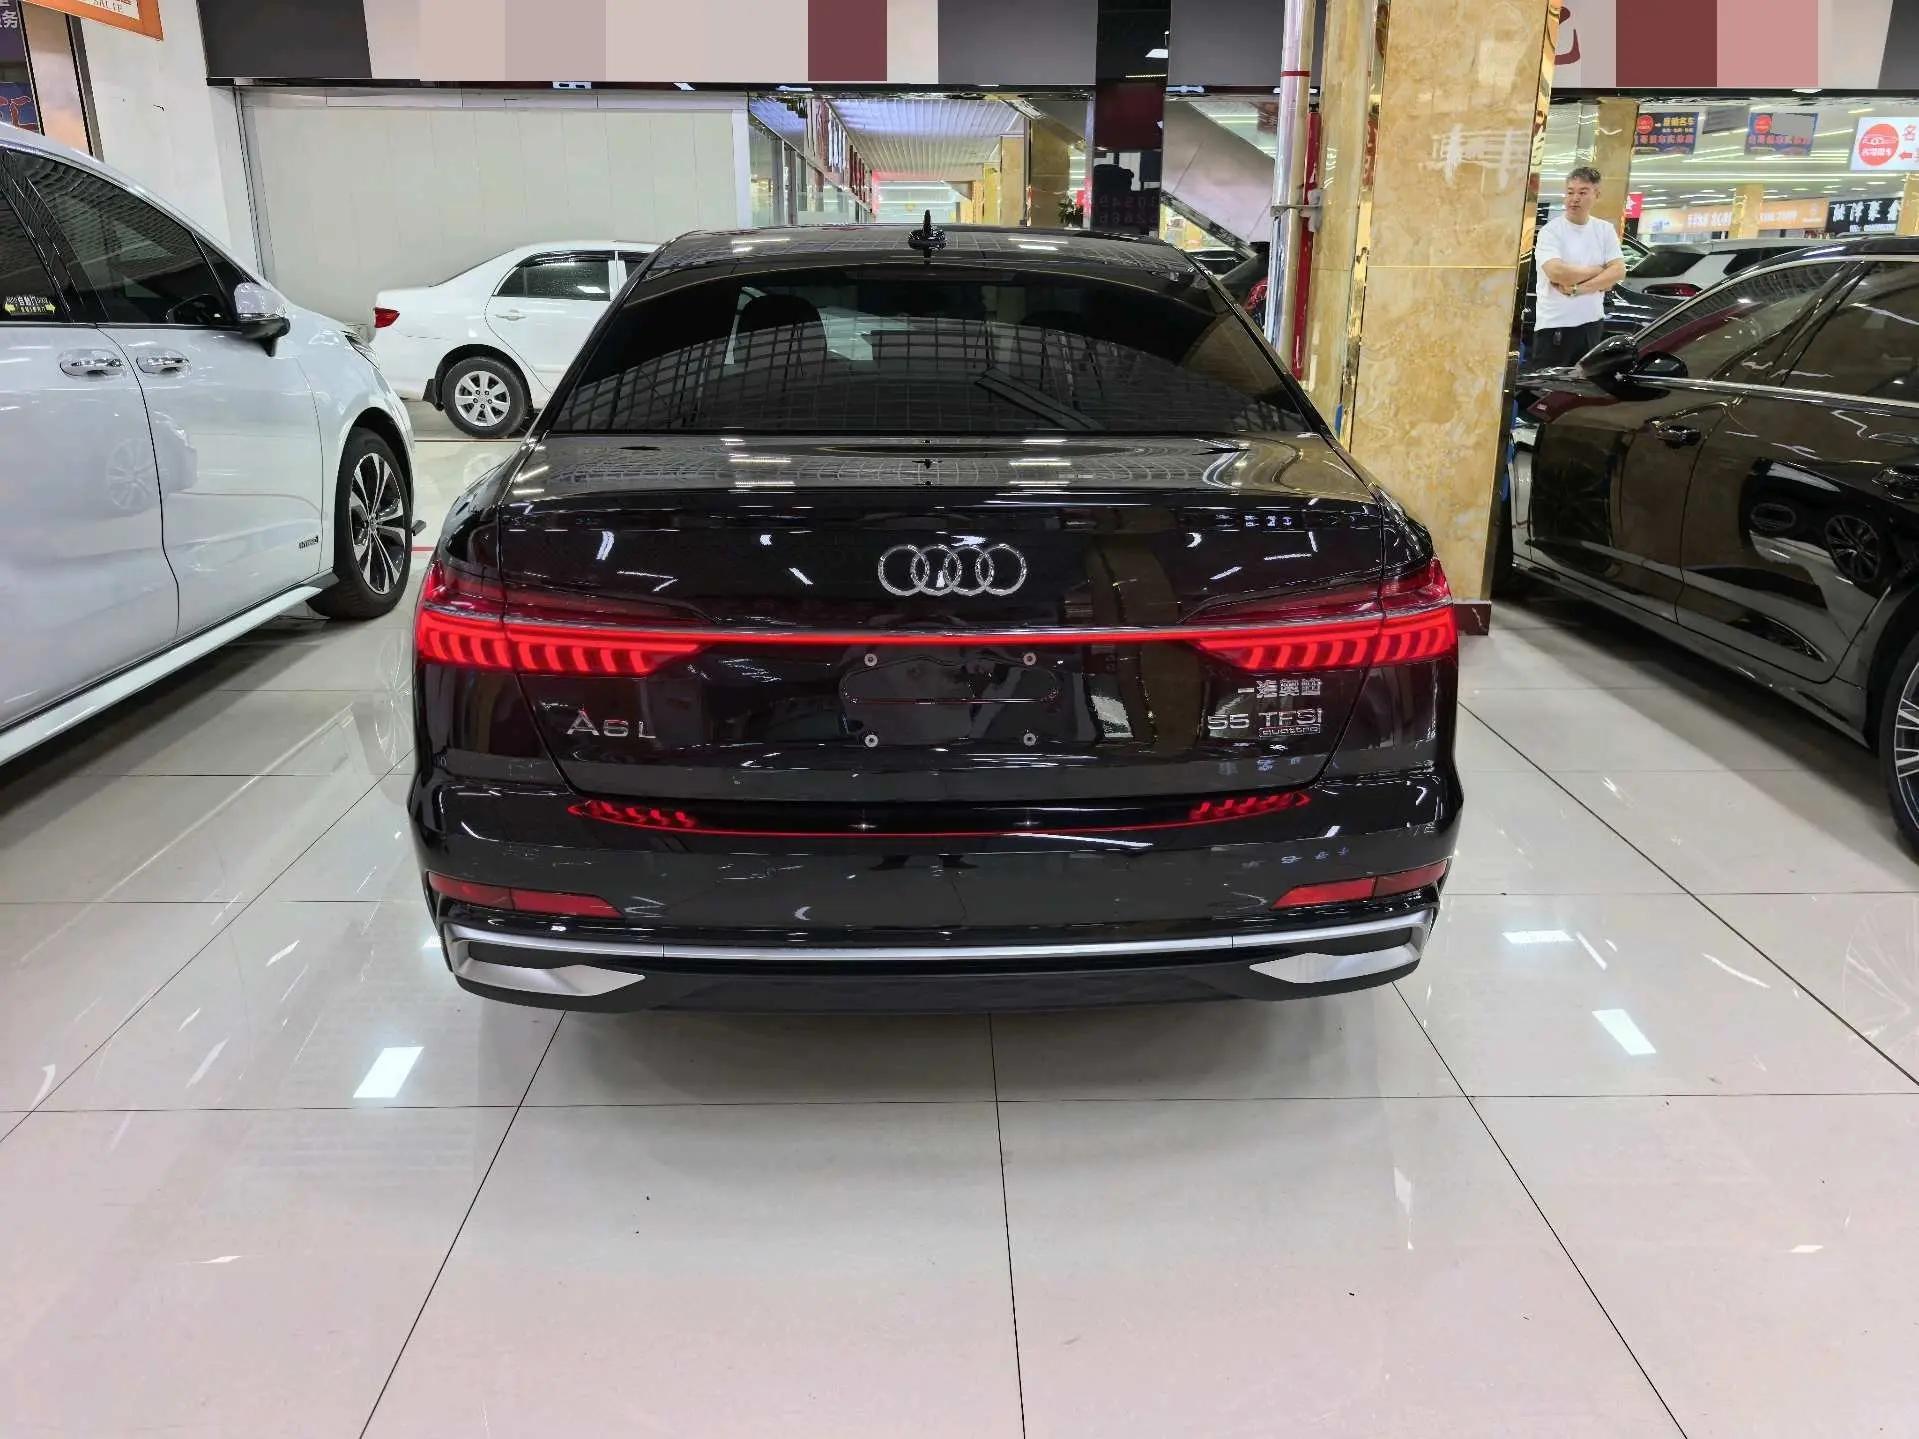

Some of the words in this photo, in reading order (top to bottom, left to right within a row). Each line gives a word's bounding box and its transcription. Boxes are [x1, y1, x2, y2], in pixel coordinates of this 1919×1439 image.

[1207, 713, 1250, 730] 55
[1258, 707, 1323, 726] TFSI
[1261, 726, 1320, 737] quattro
